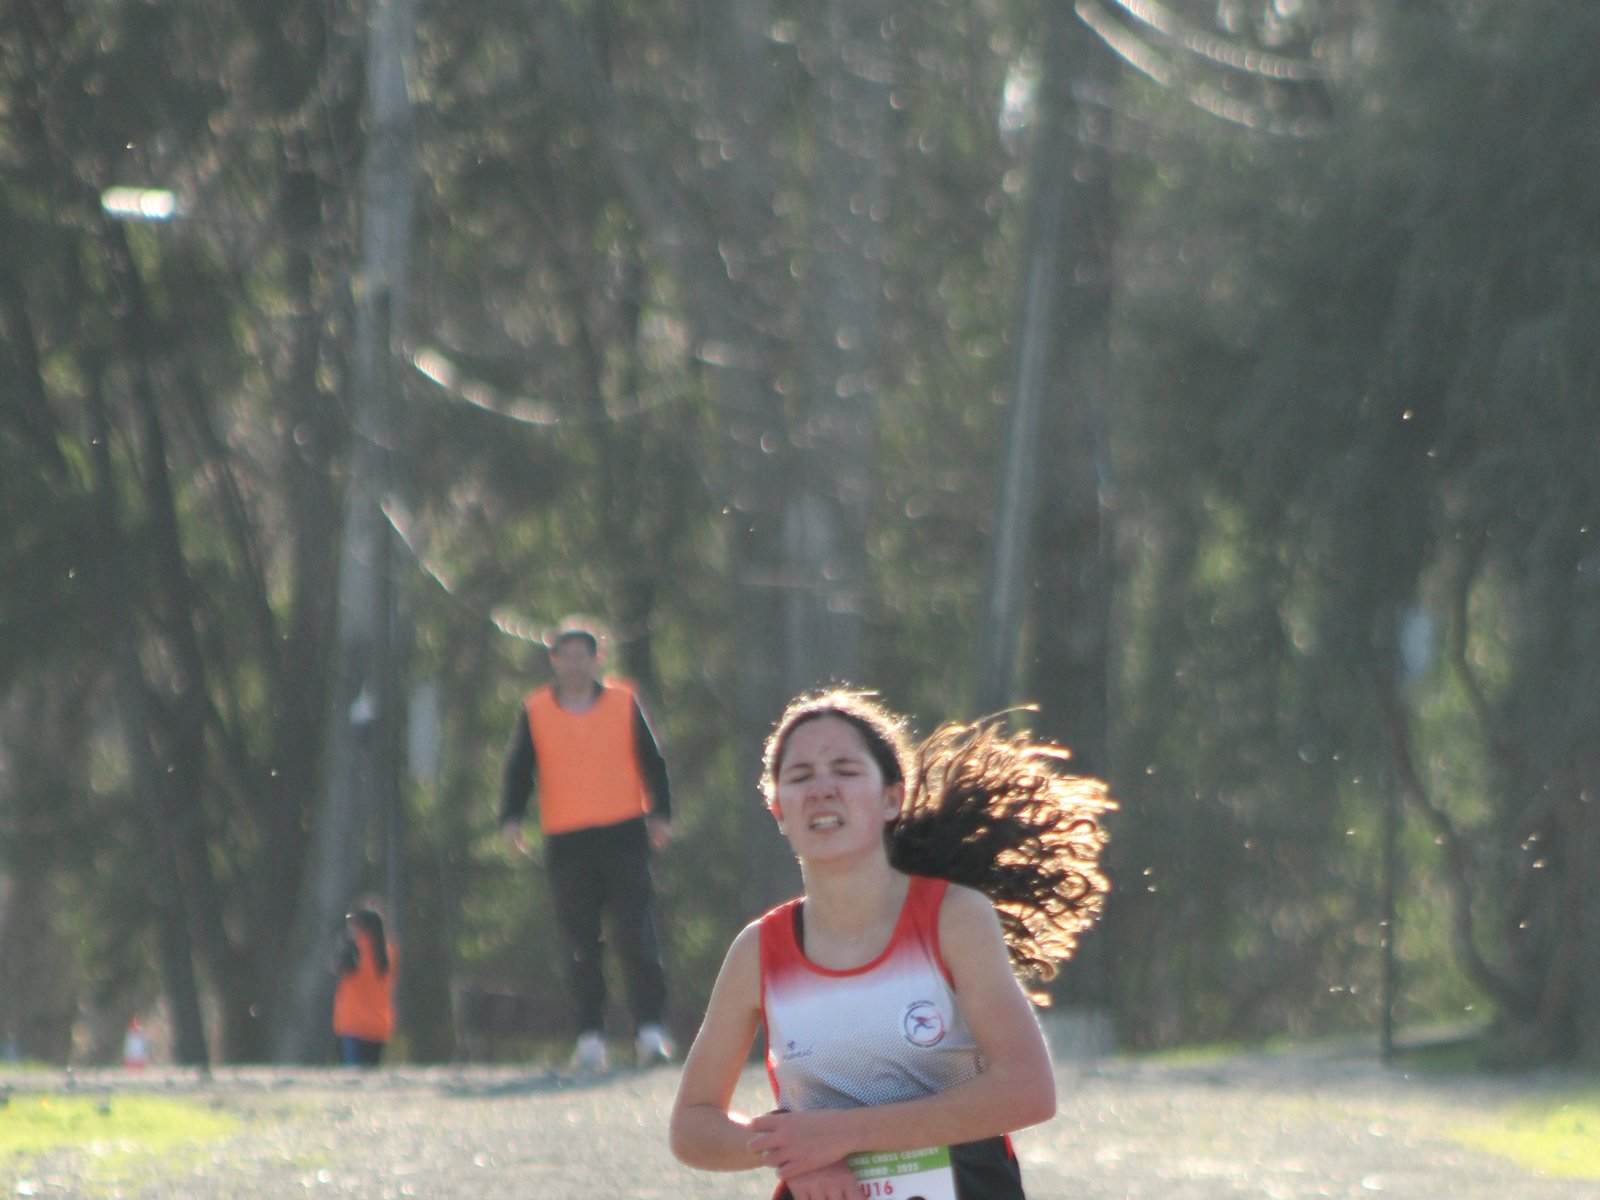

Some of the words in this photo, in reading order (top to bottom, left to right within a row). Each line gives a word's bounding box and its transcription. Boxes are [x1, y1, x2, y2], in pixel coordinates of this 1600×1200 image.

[871, 1153, 898, 1163] CROSS
[900, 1147, 938, 1160] COUNTRY
[896, 1162, 919, 1174] 2025
[860, 1180, 893, 1198] U16
